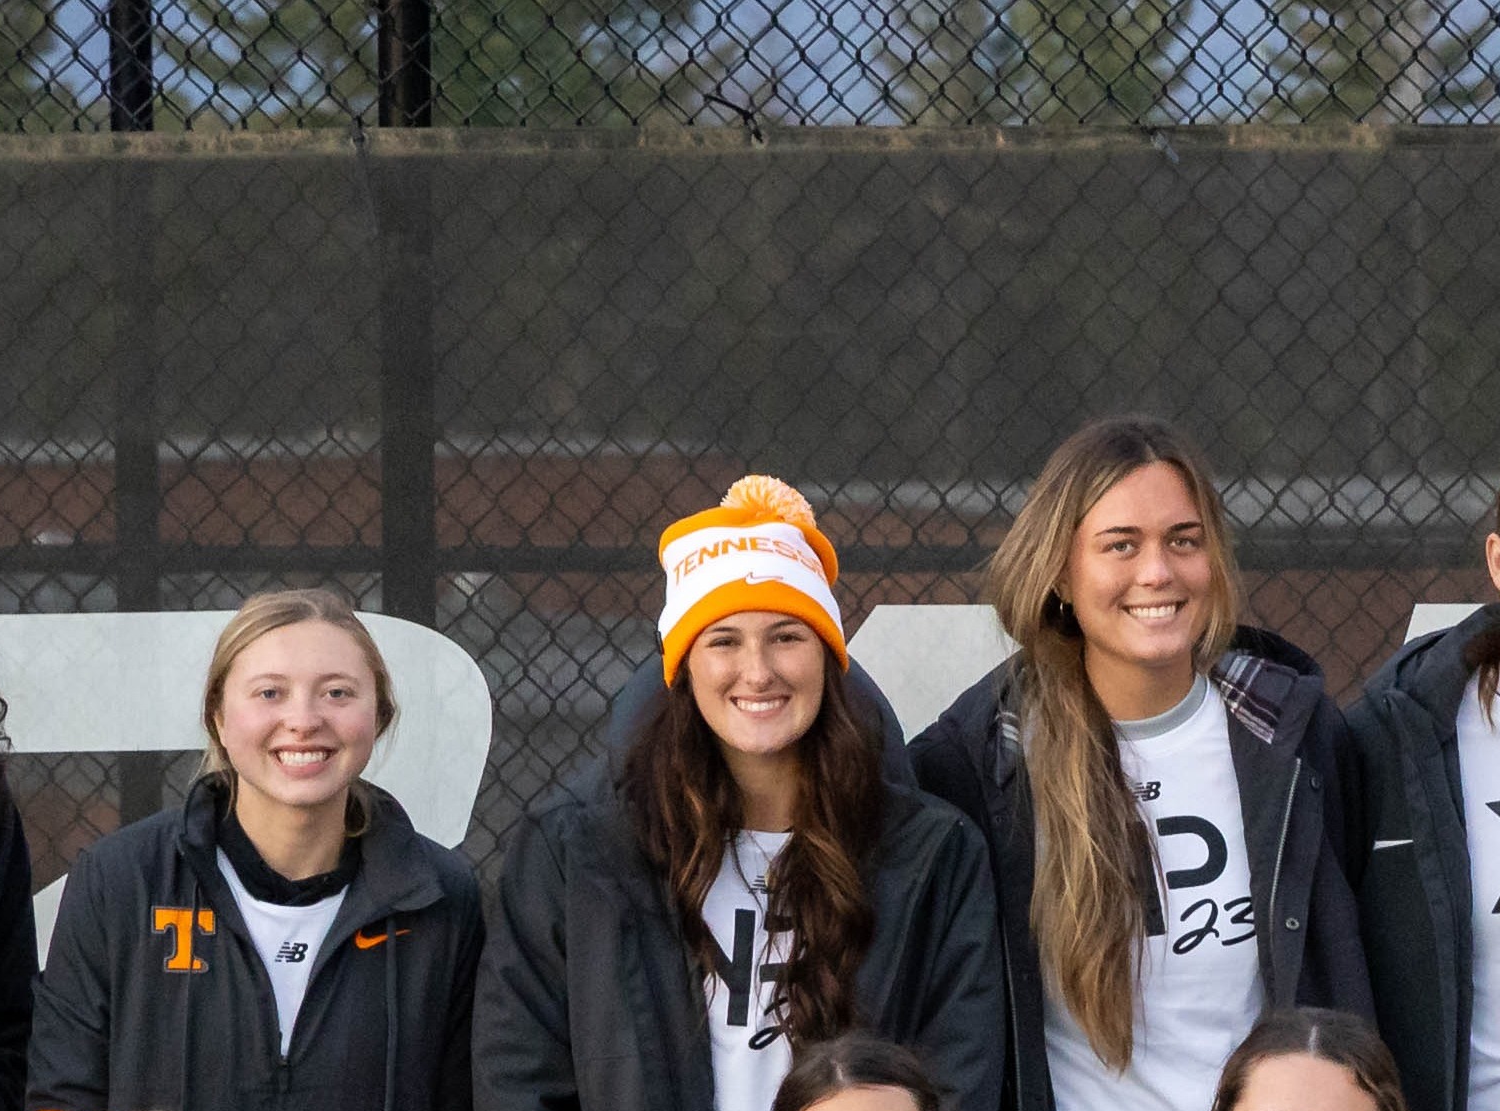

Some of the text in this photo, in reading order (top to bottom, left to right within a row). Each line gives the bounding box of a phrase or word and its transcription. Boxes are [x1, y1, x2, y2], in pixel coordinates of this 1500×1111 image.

[673, 536, 826, 585] TENNESS
[151, 905, 216, 973] T
[1172, 896, 1256, 955] 23
